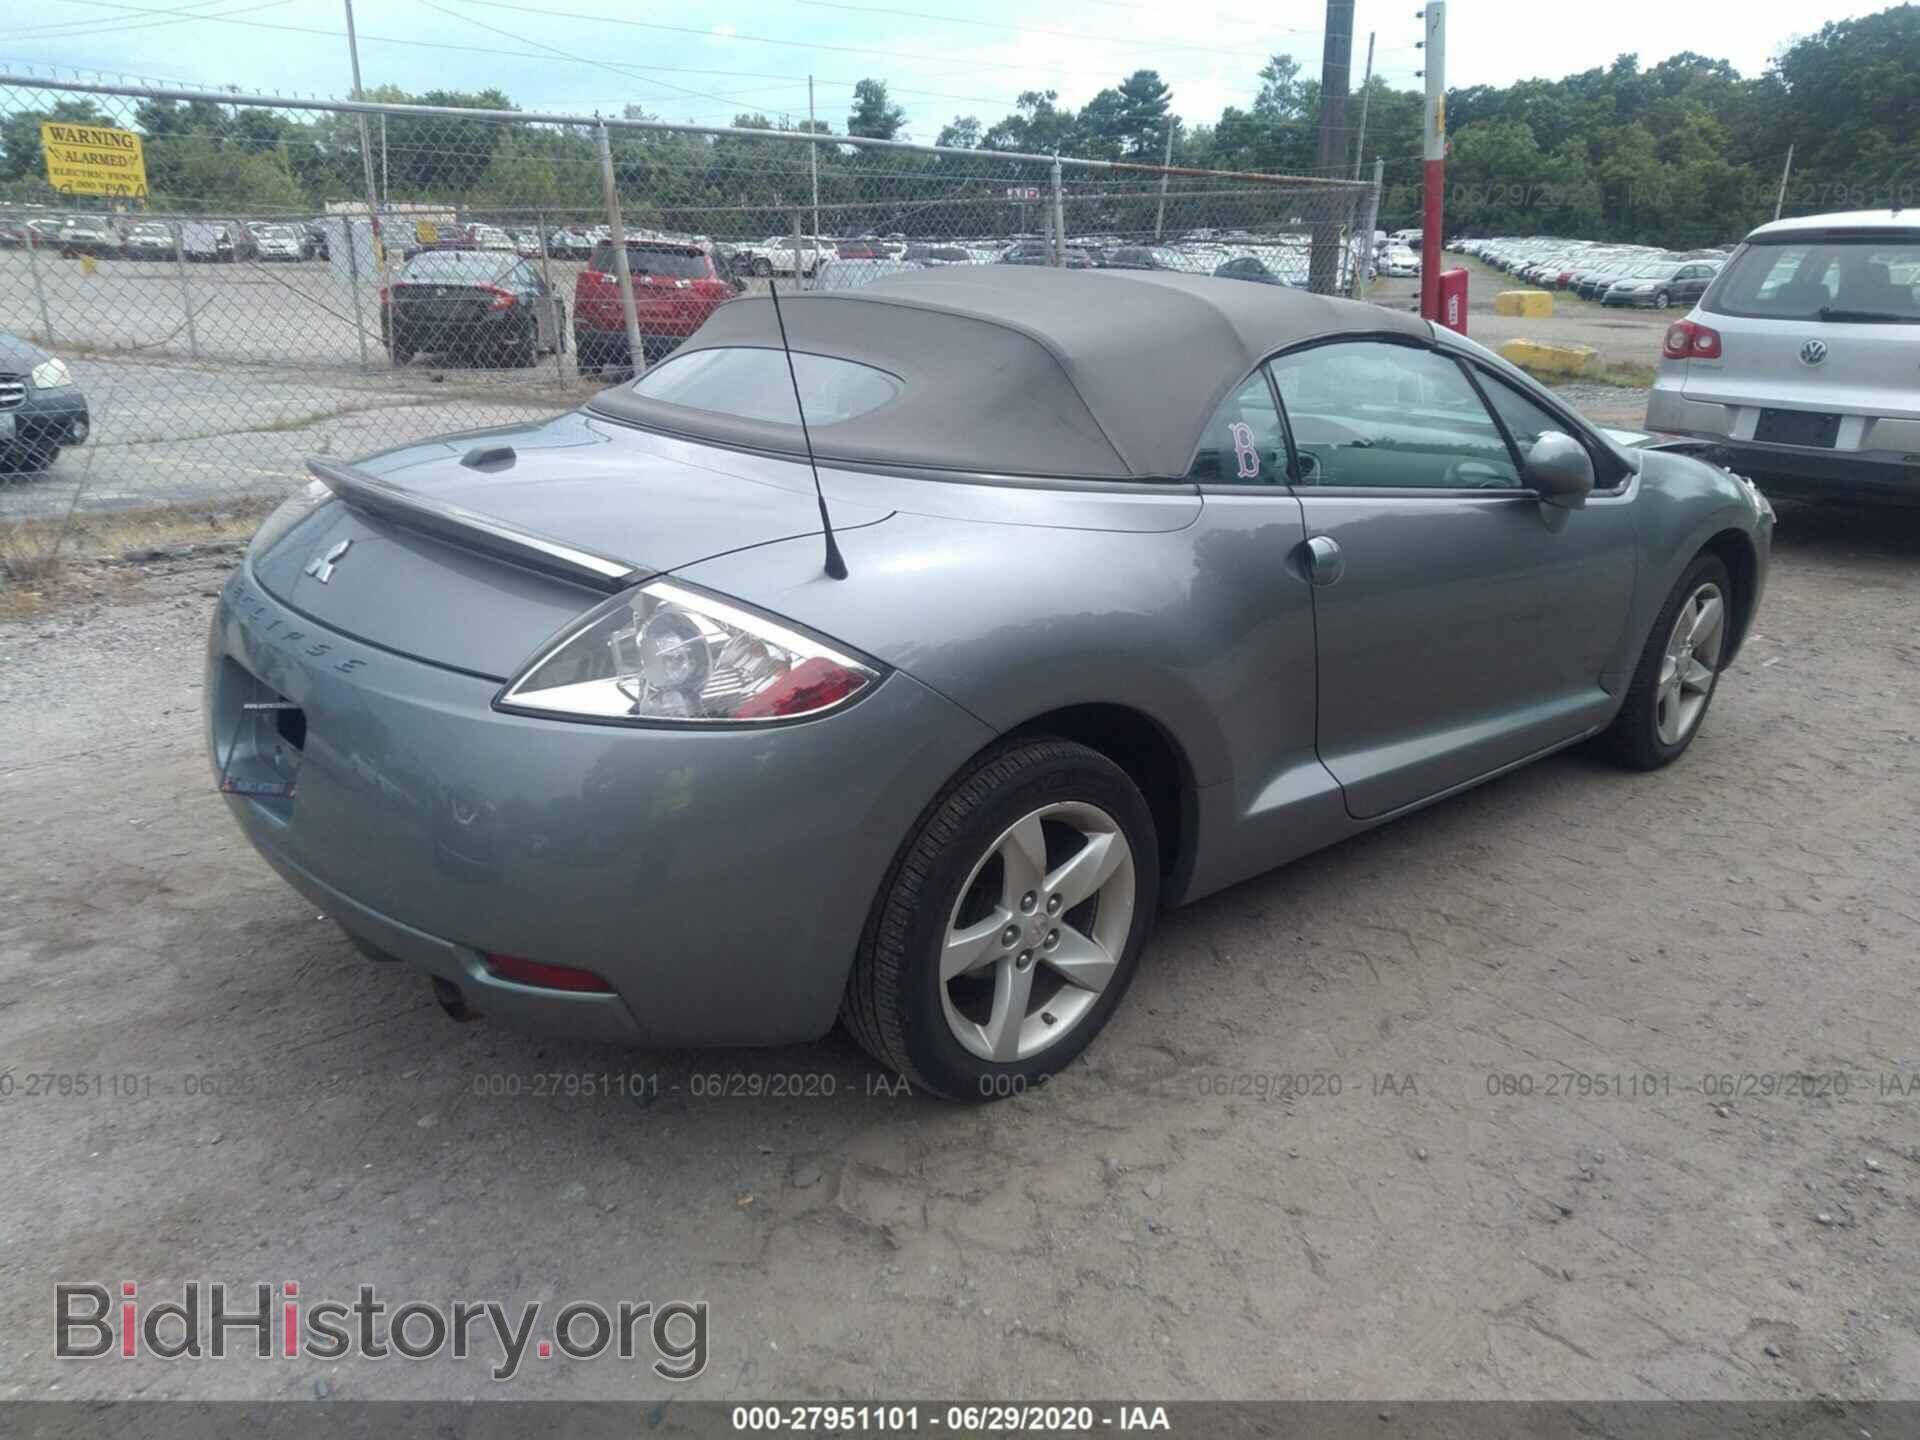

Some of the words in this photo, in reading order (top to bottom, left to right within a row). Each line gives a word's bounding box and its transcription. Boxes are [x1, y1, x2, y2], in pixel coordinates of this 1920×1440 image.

[50, 127, 134, 148] WARNING
[64, 151, 128, 167] ALARMED
[1228, 422, 1260, 478] B
